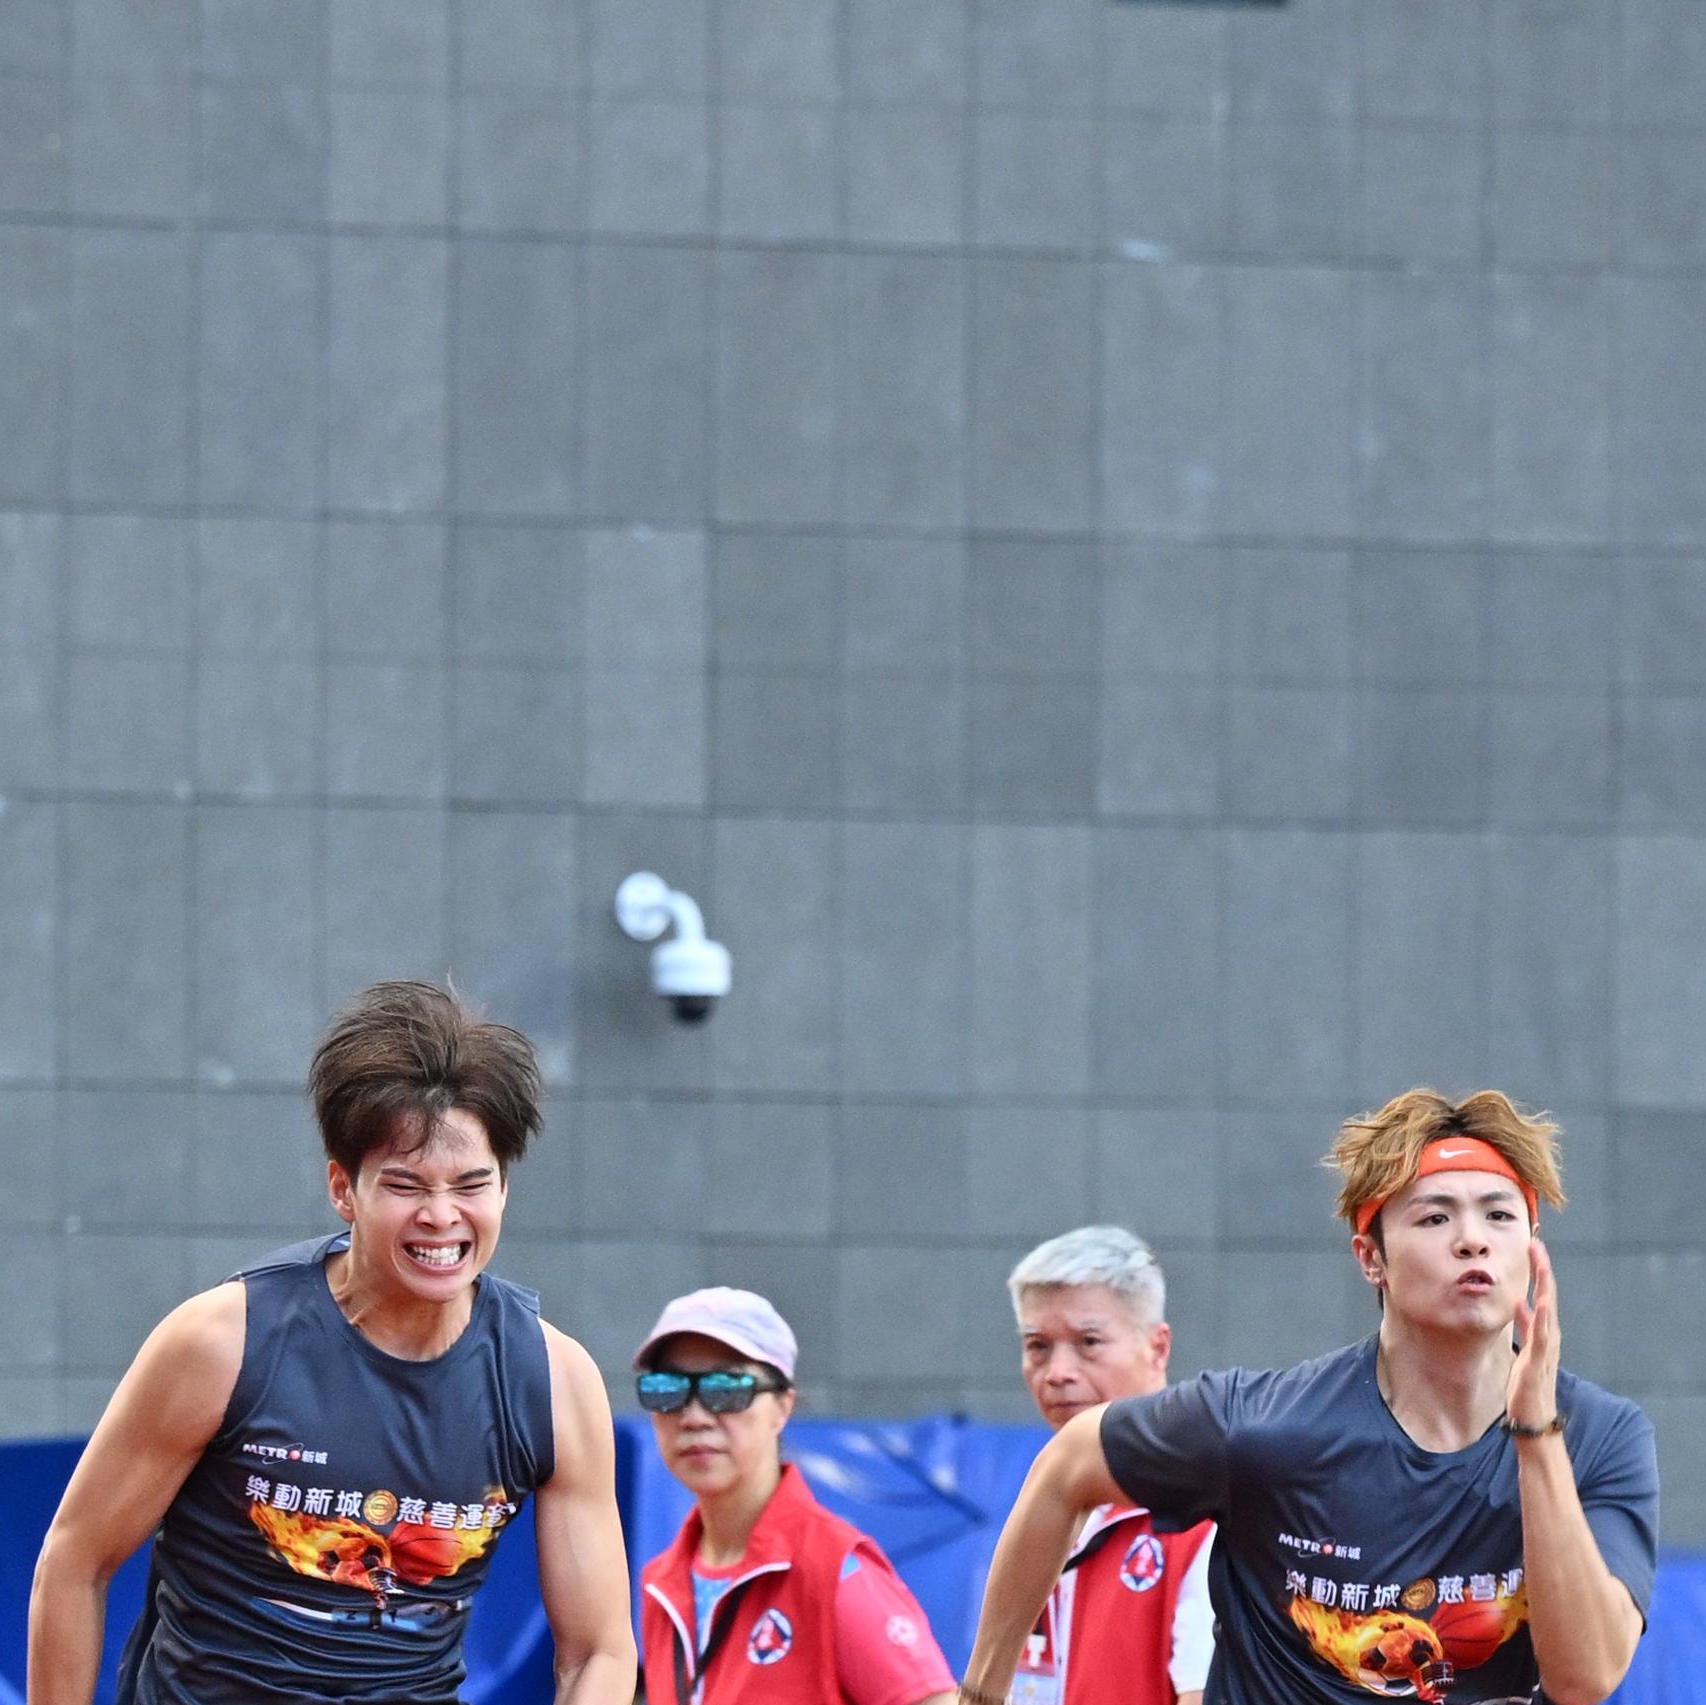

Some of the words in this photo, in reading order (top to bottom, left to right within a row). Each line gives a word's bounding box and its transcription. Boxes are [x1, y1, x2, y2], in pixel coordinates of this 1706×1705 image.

[245, 1474, 363, 1519] 樂動新城
[396, 1496, 517, 1531] 慈善運音
[1285, 1568, 1402, 1612] 樂動新城
